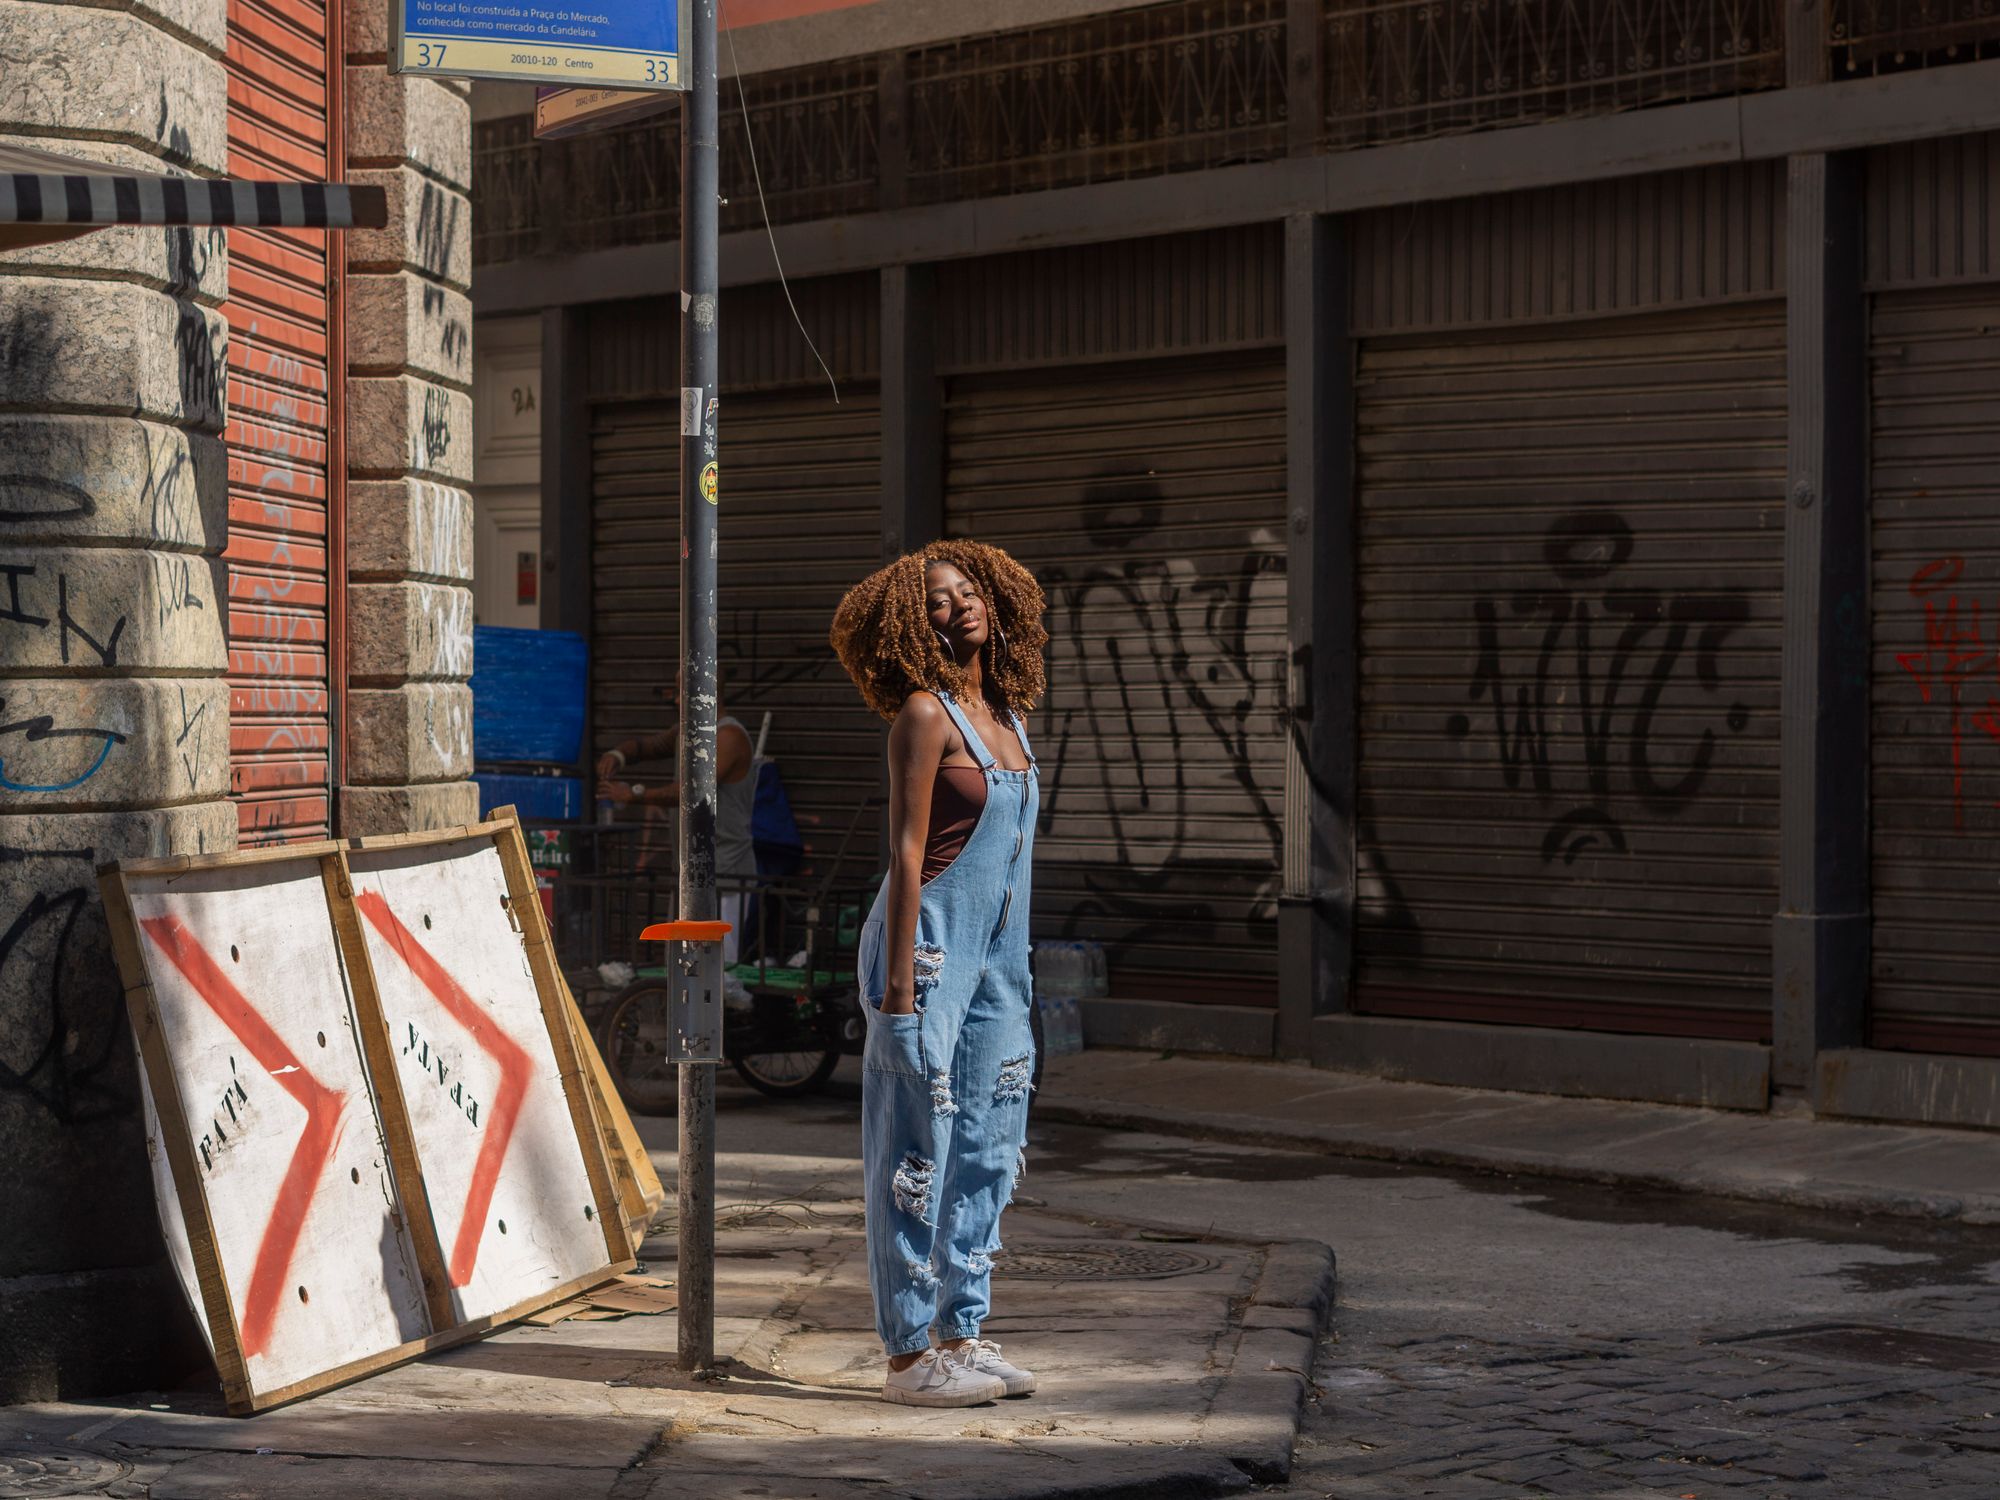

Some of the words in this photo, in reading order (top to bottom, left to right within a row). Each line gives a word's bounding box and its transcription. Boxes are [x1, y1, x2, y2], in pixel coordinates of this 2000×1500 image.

[417, 1, 432, 11] No
[434, 2, 456, 13] local
[459, 4, 471, 13] foi
[530, 8, 555, 20] Praça
[556, 11, 569, 21] do
[571, 12, 610, 25] Mercado,
[417, 17, 465, 28] conhecida
[467, 20, 494, 30] como
[496, 22, 536, 33] mercado
[537, 24, 549, 34] da
[417, 43, 447, 67] 37
[511, 54, 558, 67] 20010-120
[565, 58, 594, 70] Centro
[645, 59, 670, 83] 33
